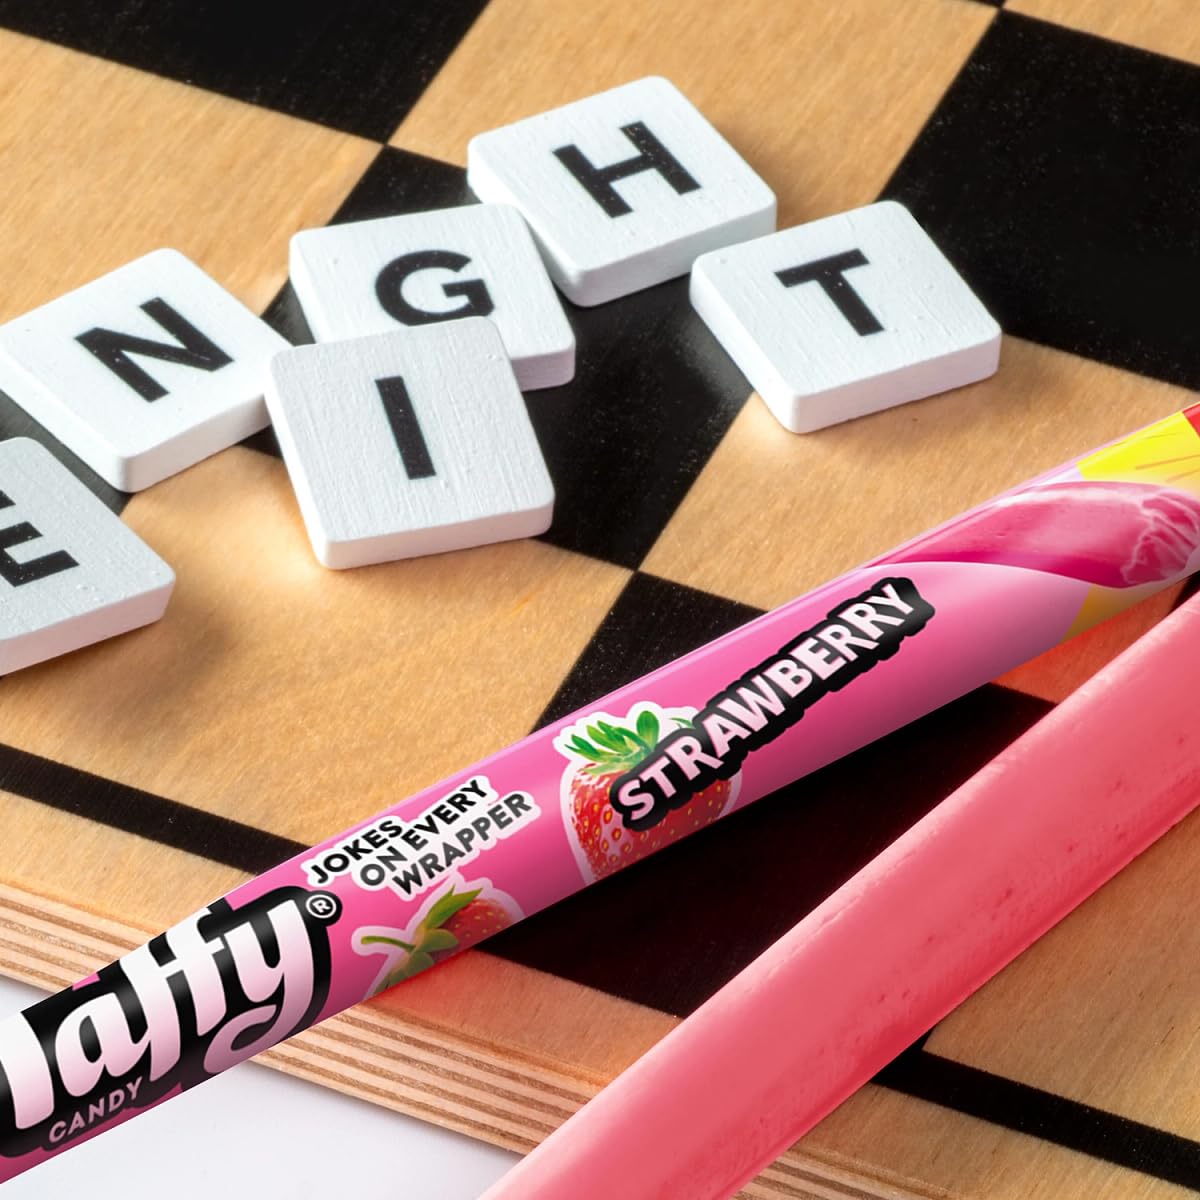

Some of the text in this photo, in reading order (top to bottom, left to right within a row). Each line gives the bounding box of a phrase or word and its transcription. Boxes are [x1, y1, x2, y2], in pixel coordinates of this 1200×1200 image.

[618, 584, 915, 822] STRAWBERRY
[310, 819, 402, 884] JOKES
[360, 779, 488, 886] ON EVERY
[392, 793, 532, 895] WRAPPER
[49, 1077, 143, 1143] CANDY
